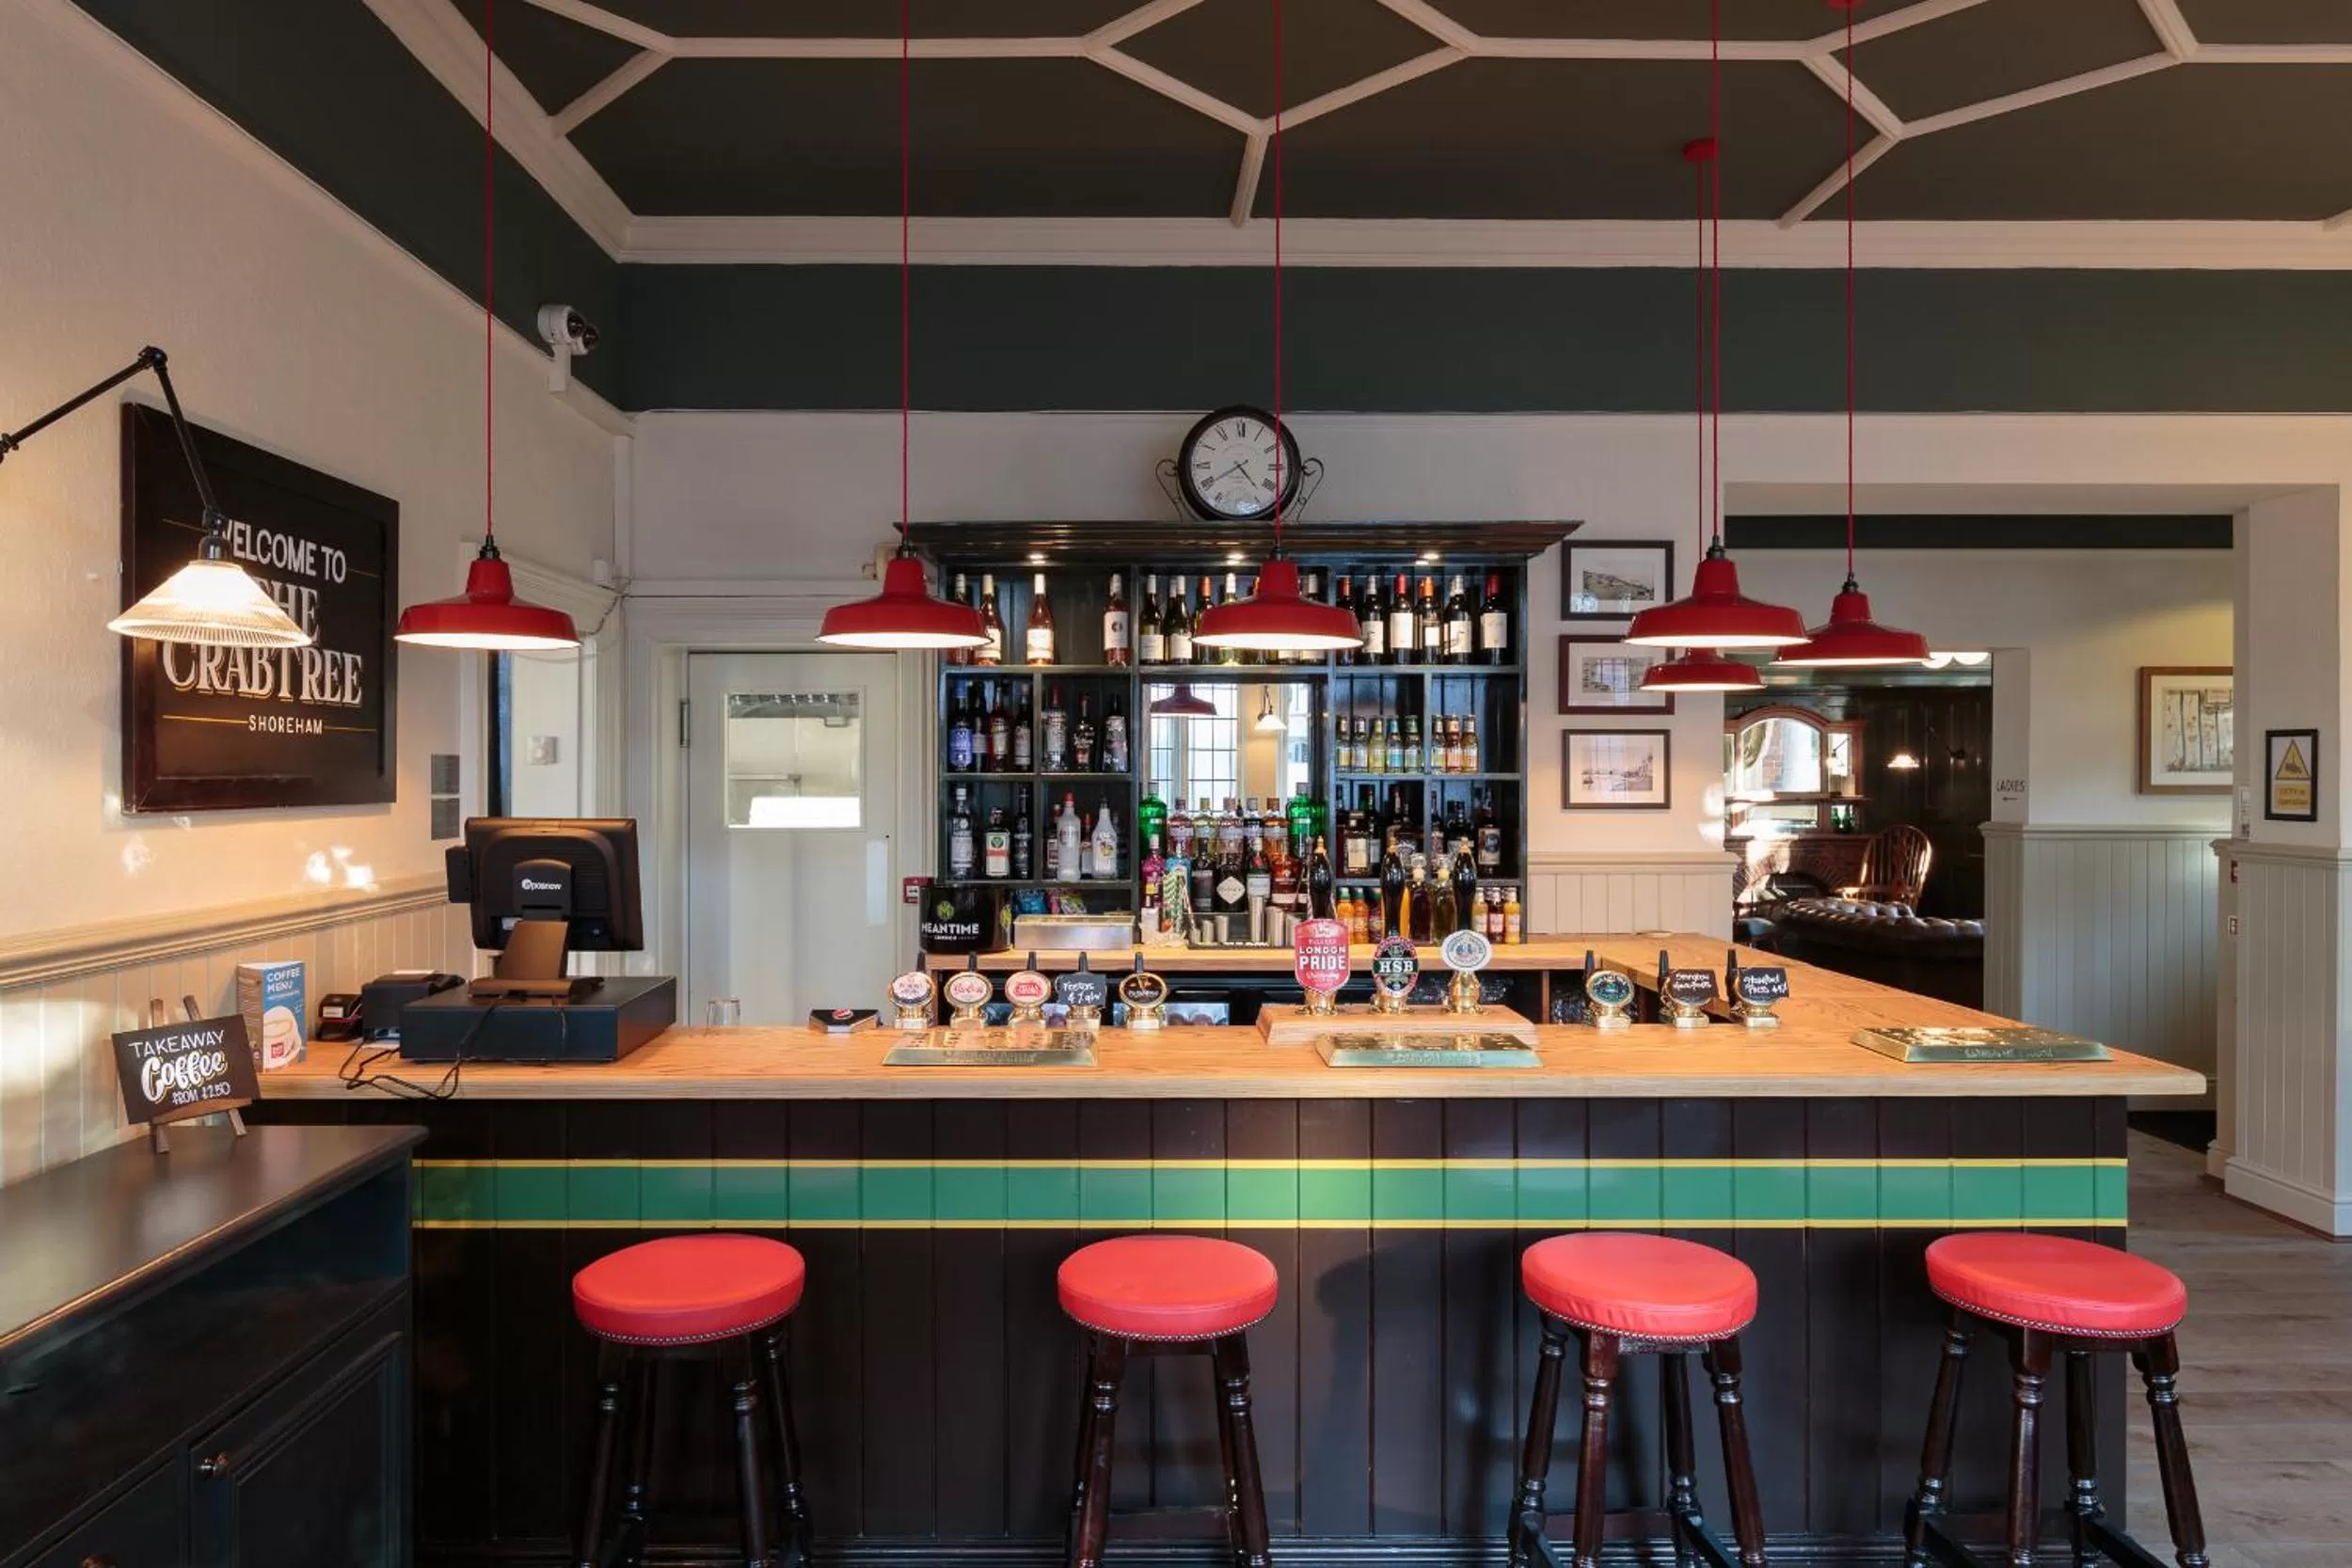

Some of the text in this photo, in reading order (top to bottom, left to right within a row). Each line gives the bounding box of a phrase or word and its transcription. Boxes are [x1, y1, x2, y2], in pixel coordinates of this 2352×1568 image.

[321, 546, 347, 583] TO
[162, 641, 363, 708] CRABTREE
[247, 714, 323, 735] SHOREHAM
[921, 923, 979, 935] MEANTIME
[1299, 946, 1346, 955] LONDON
[1299, 956, 1346, 971] PRIDE
[1378, 959, 1414, 974] HSB
[266, 968, 301, 983] COFFEE
[128, 1029, 225, 1058] TAKEAWAY
[141, 1050, 228, 1104] Coffee
[171, 1089, 199, 1105] FROM
